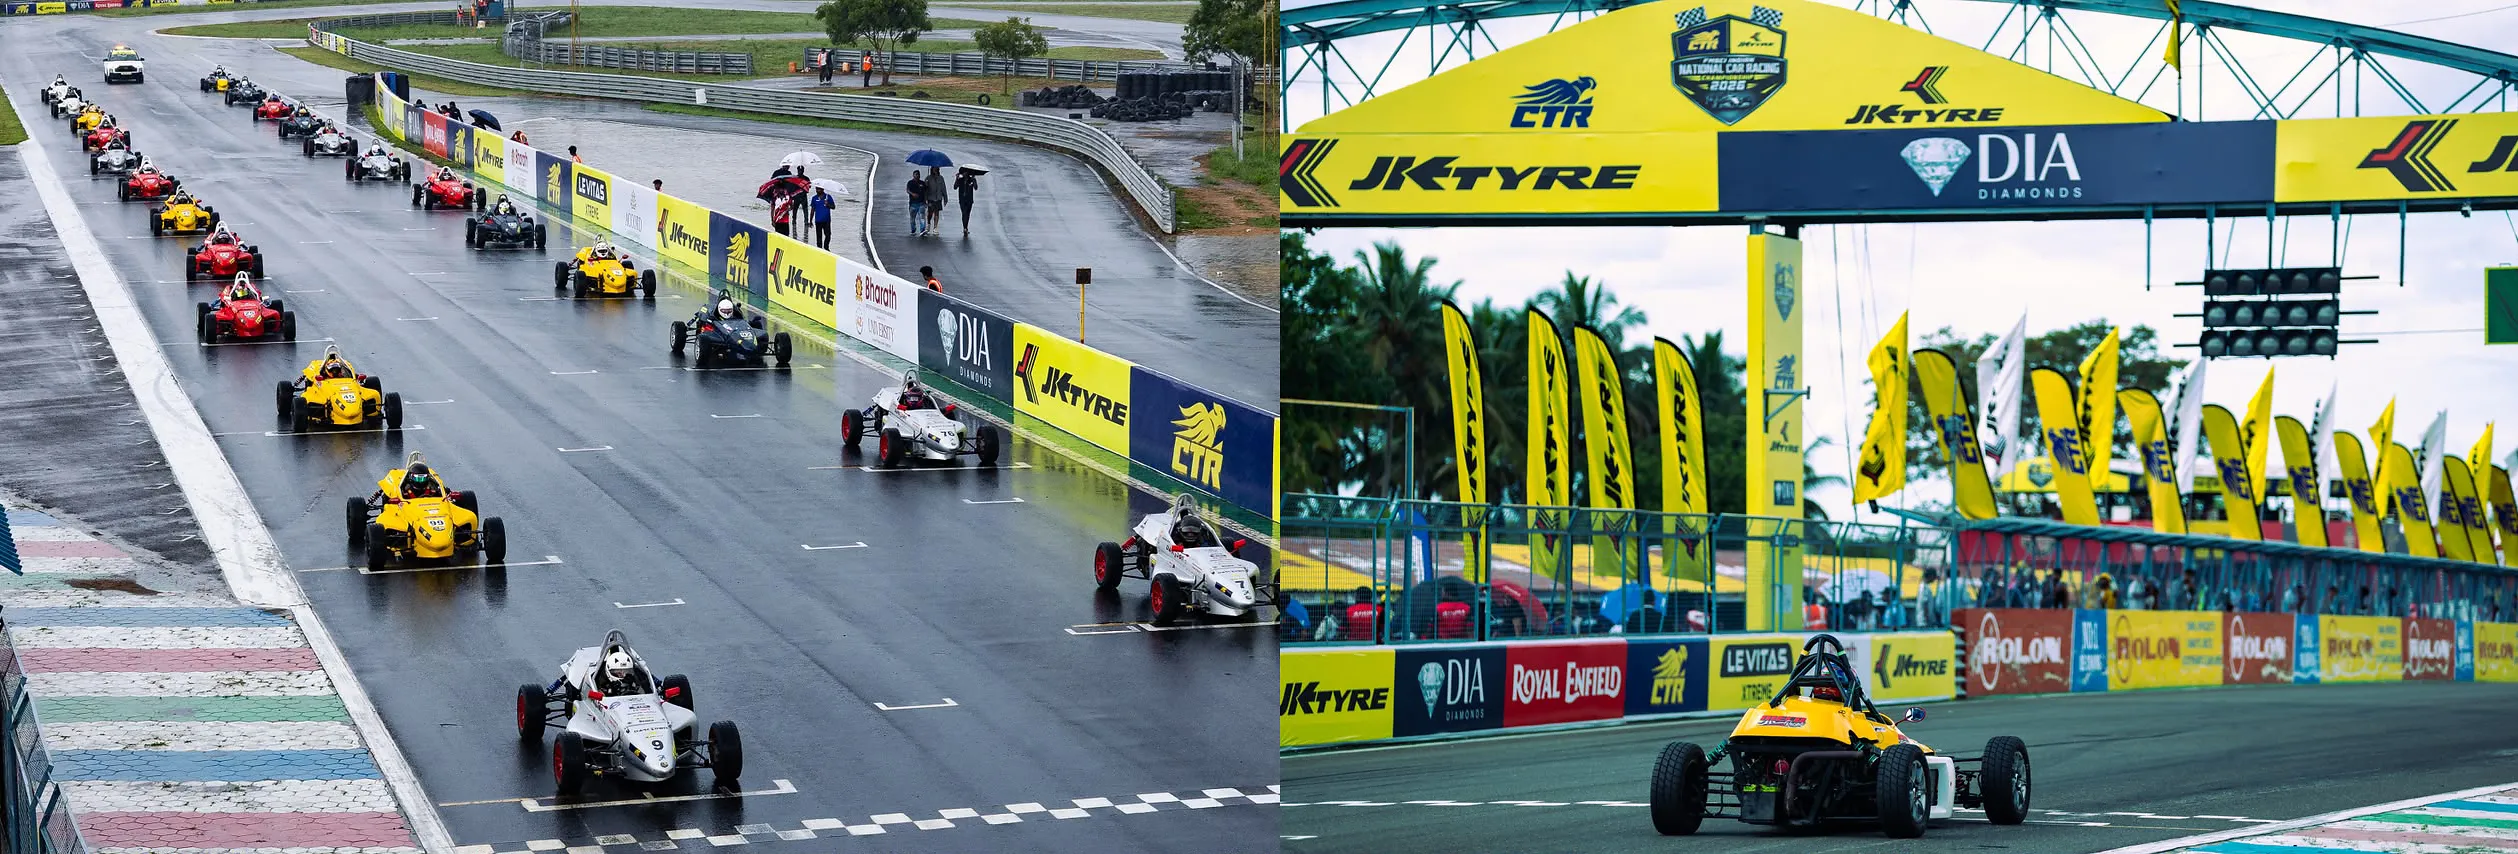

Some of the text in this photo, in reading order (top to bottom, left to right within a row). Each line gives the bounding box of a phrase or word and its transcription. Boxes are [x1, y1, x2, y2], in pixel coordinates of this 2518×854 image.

[1679, 63, 1780, 75] NATIONAL CAR RACING
[1510, 105, 1594, 128] CTR
[1978, 132, 2082, 183] DIA
[1978, 186, 2082, 200] DIAMONDS
[725, 256, 750, 288] CTR
[865, 275, 897, 311] Bharath
[959, 312, 992, 371] DIA
[959, 366, 992, 389] DIAMONDS
[2062, 428, 2085, 475] CTR
[2154, 440, 2173, 484] CTR
[1171, 436, 1224, 492] CTR
[1234, 580, 1245, 589] 7
[2117, 637, 2181, 661] ROLON
[2232, 636, 2287, 659] ROLON
[2409, 638, 2450, 658] ROLON
[1447, 658, 1485, 706] DIA
[1512, 662, 1622, 704] ROYAL ENFIELD
[1651, 677, 1686, 705] CTR
[1741, 683, 1773, 701] XTREME
[1446, 708, 1485, 722] DIAMONDS
[651, 739, 664, 751] 9
